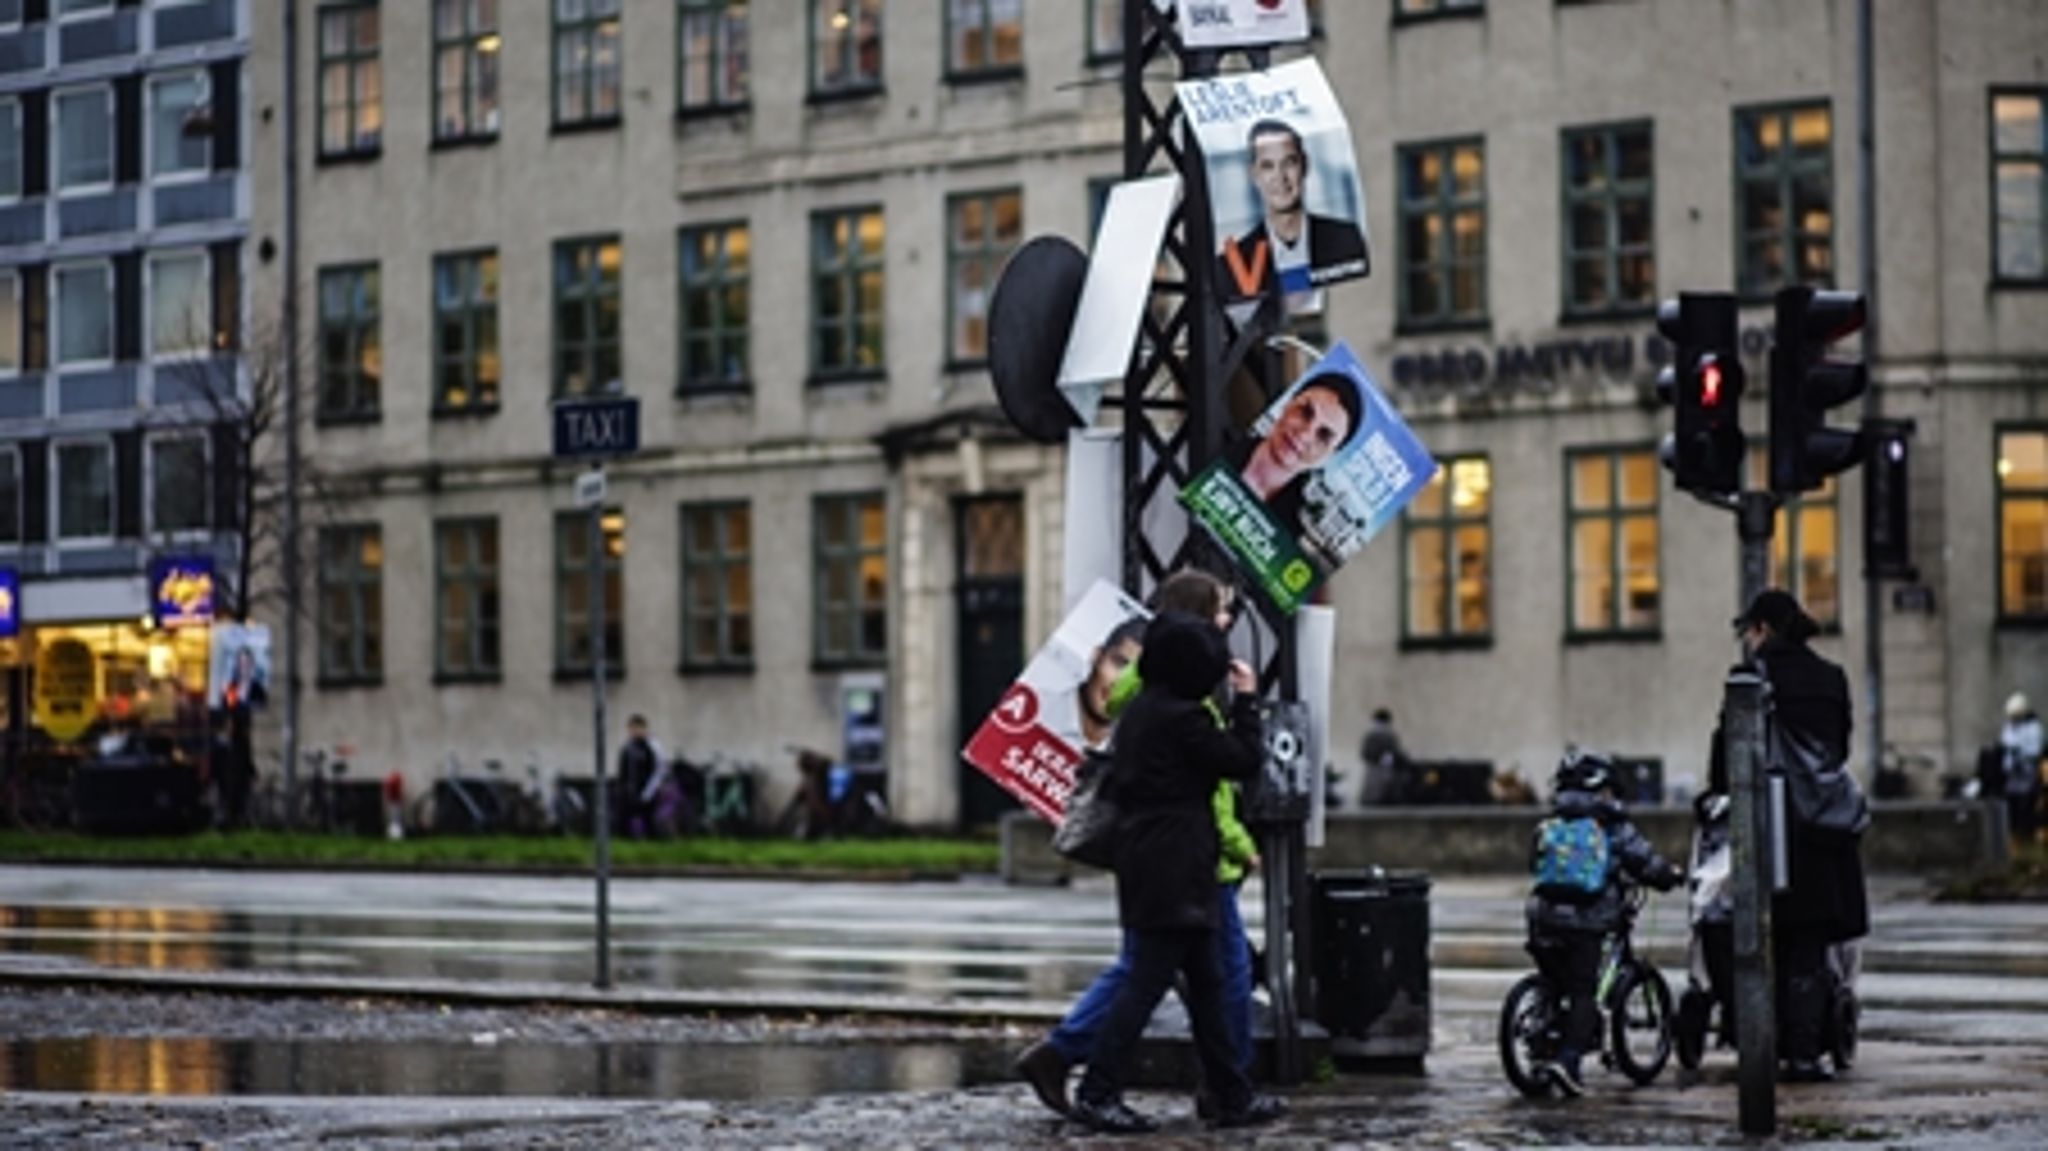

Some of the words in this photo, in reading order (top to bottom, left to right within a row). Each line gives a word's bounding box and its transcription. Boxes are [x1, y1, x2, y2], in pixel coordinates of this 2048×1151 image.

[1224, 236, 1268, 297] V
[563, 409, 626, 448] TAXI
[1001, 694, 1027, 720] A
[1001, 747, 1072, 804] SARW
[1032, 740, 1079, 784] IKRA
